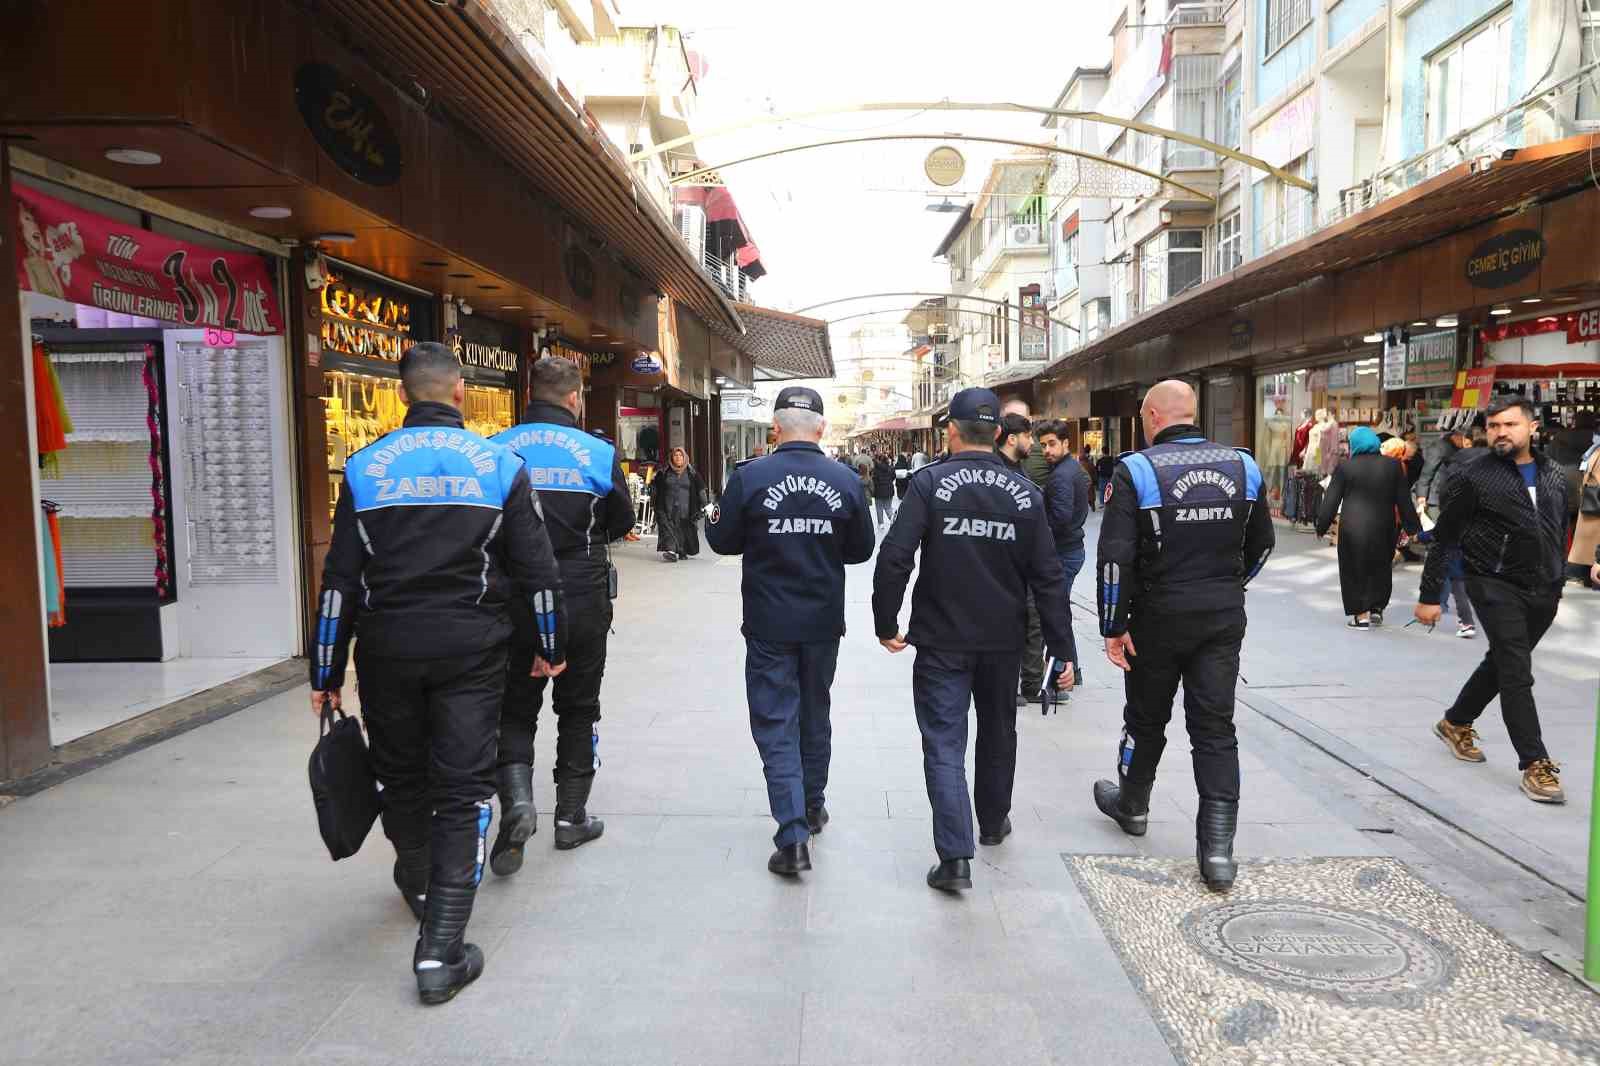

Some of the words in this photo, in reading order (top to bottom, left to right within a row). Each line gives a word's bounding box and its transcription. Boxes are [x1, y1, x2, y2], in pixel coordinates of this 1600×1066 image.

[107, 234, 140, 260] TÜM
[1511, 239, 1541, 265] GİYİM
[92, 282, 179, 321] ÜRÜNLERİNDE
[211, 257, 240, 331] 2
[1579, 309, 1600, 337] CE
[465, 342, 518, 373] KUYUMCULUK
[375, 475, 484, 502] ZABITA
[530, 467, 584, 487] BITA
[935, 468, 1033, 511] BÜYÜKŞEHİR
[1172, 469, 1237, 499] BÜYÜKŞEHİR
[763, 474, 843, 512] BÜYÜKŞEHİR
[767, 518, 833, 534] ZABITA
[1175, 507, 1233, 521] ZABITA
[943, 517, 1016, 541] ZABITA
